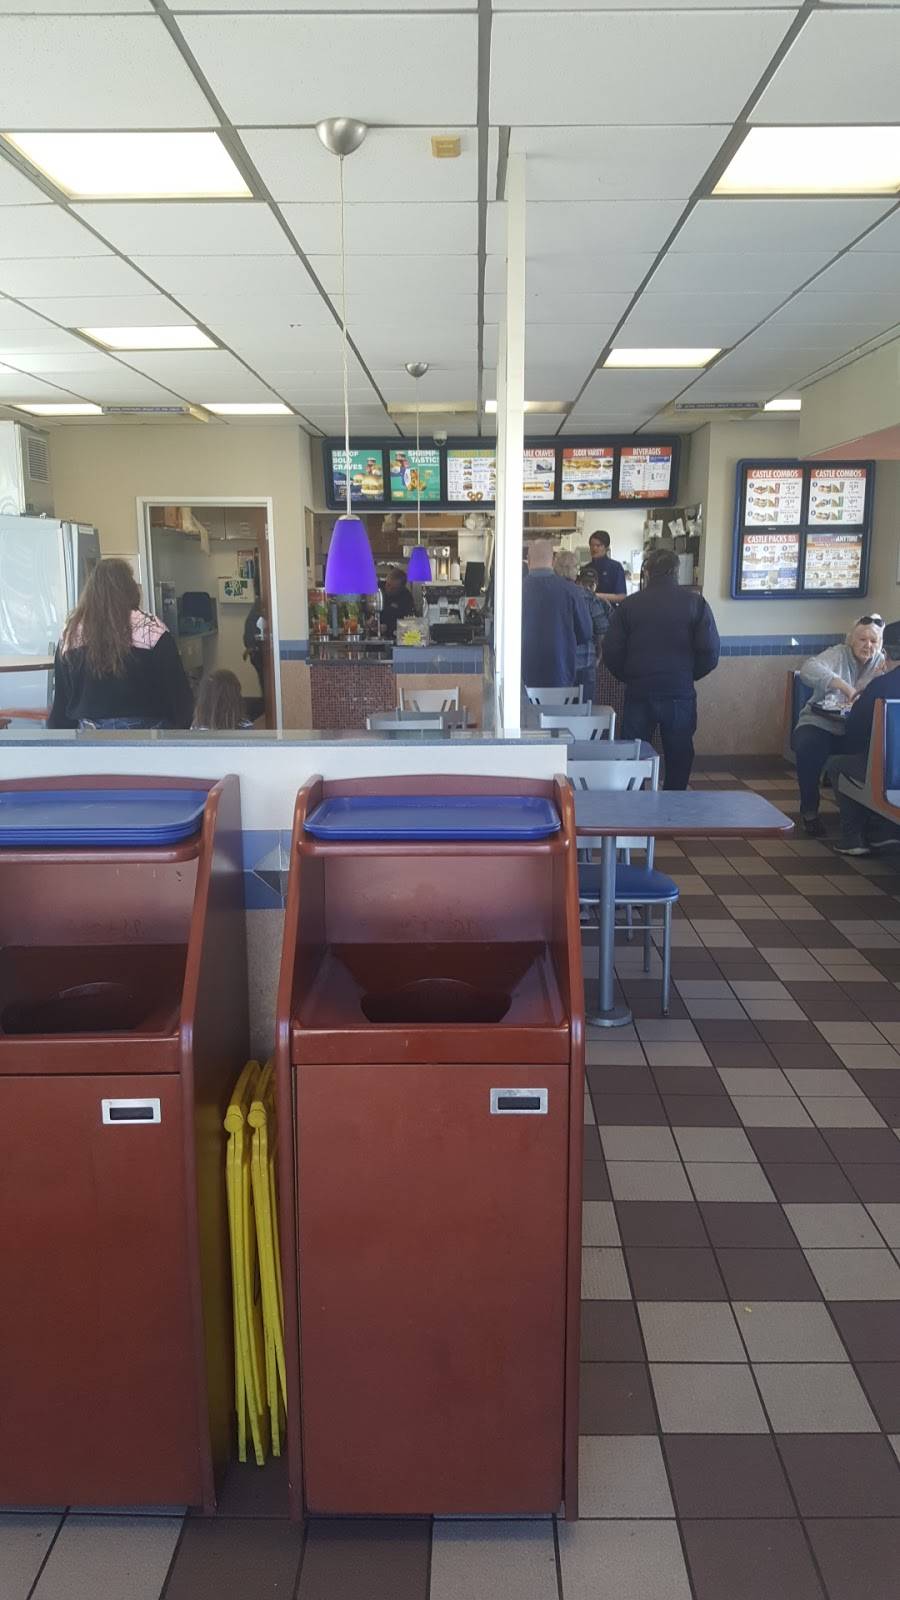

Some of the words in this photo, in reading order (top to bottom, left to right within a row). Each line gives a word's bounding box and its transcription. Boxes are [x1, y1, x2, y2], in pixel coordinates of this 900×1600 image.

[632, 447, 661, 456] BEVERAGES
[752, 470, 772, 478] CASTLE
[773, 470, 799, 478] COMBOS
[815, 470, 835, 478] CASTLE
[836, 470, 862, 478] COMBOS
[747, 535, 767, 543] CASTLE
[767, 535, 787, 543] PACKS
